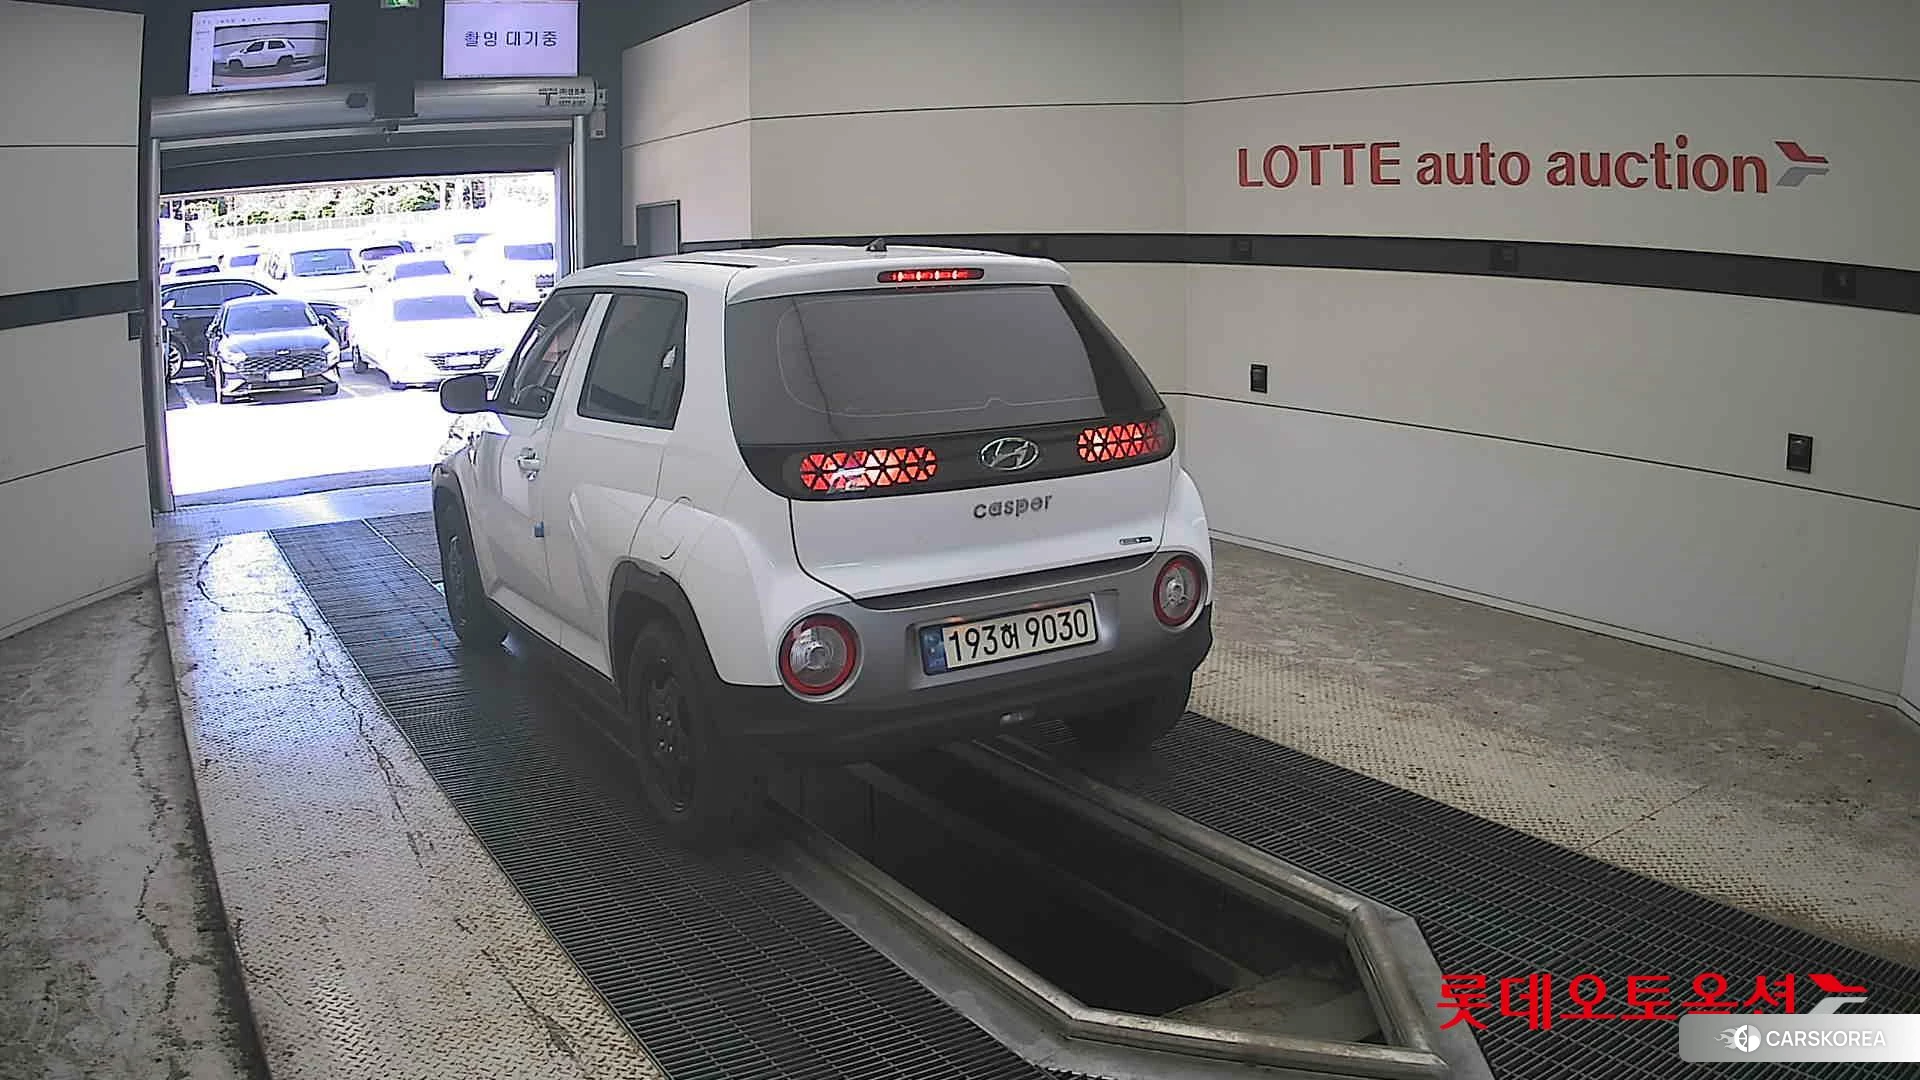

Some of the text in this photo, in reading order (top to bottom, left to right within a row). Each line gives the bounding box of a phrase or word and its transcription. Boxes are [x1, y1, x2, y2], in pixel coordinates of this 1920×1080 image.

[464, 31, 557, 47] 촬영 대기중
[1238, 135, 1769, 193] LOTTE auto auction
[974, 495, 1052, 519] casper
[949, 609, 1089, 661] 193허 9030
